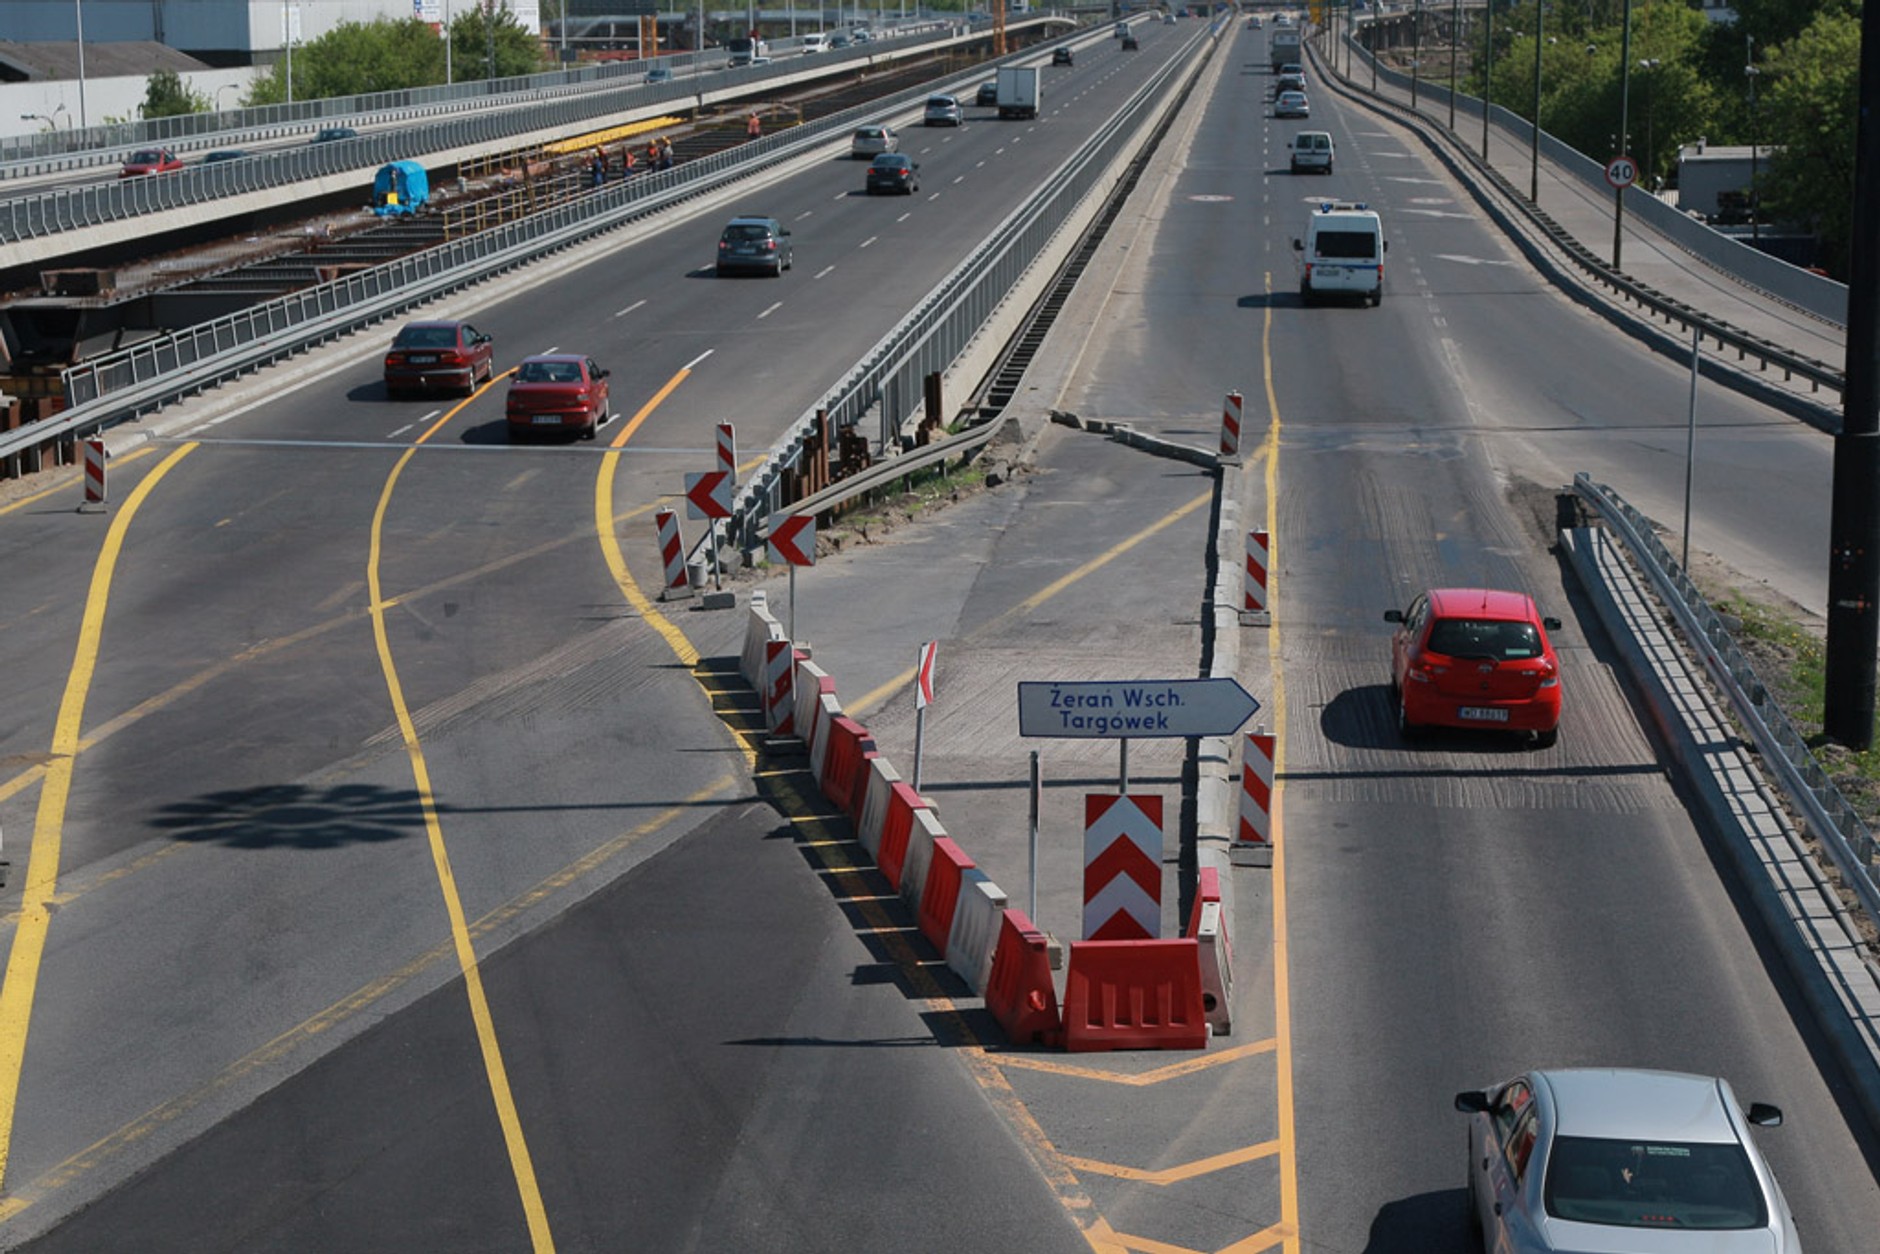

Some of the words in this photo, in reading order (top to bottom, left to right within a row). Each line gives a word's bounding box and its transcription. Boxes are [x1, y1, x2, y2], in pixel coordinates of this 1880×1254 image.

[1610, 165, 1633, 180] 40
[1050, 683, 1114, 708] Żerań
[1122, 688, 1186, 708] Wsch.
[1059, 710, 1169, 734] Targówek
